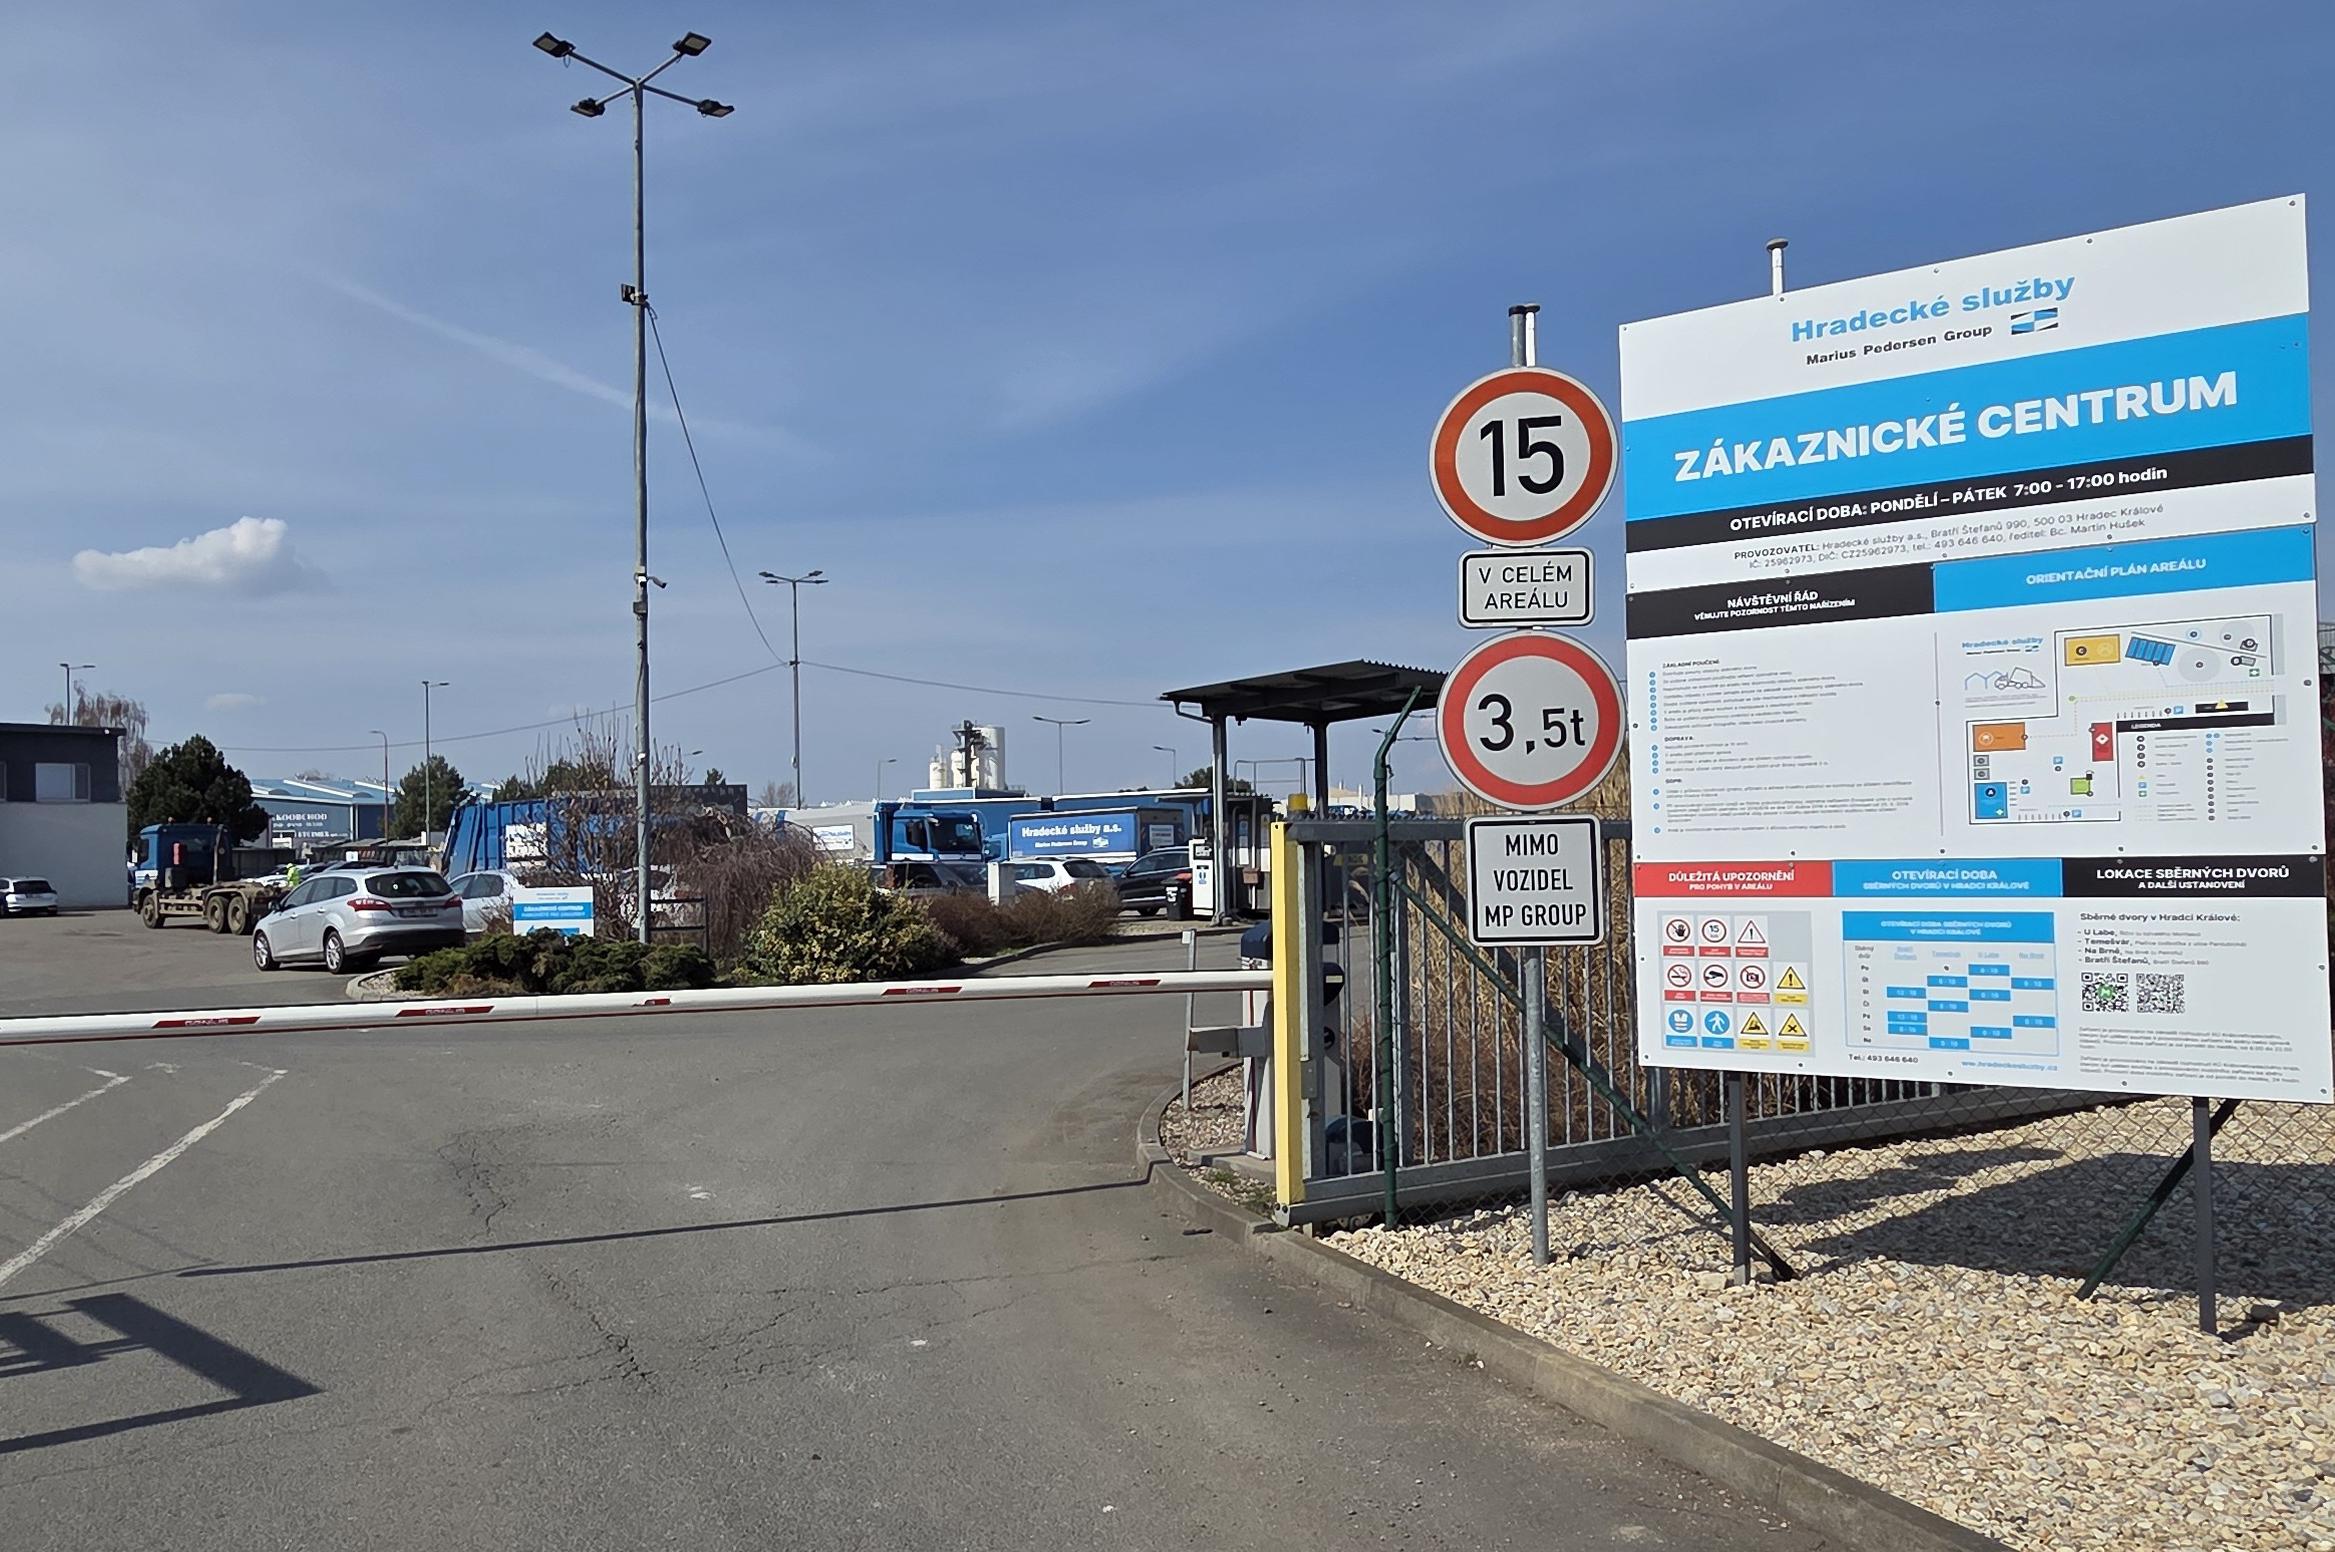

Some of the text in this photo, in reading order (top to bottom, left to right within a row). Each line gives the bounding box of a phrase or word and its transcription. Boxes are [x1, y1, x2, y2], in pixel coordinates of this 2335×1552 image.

[1792, 276, 2075, 342] Hradecké služby
[1806, 325, 1993, 365] Marius Pedersen Group
[1674, 370, 2238, 482] ZÁKAZNICKÉ CENTRUM
[1480, 415, 1564, 497] 15
[1729, 507, 1814, 531] OTEVÍRACÍ
[1816, 504, 1867, 521] DOBA:
[1870, 491, 1939, 514] PONDĚLÍ
[1952, 487, 2007, 504] PÁTEK
[2014, 480, 2052, 496] 7:00
[2066, 473, 2115, 490] 17:00
[2118, 466, 2168, 484] hodin
[1734, 543, 1820, 560] PROVOZOVATEL:
[1822, 538, 1869, 550] Hradecké
[1872, 533, 1904, 545] služby
[1931, 527, 1959, 538] Bratří
[1961, 523, 2003, 535] Štefanů
[2006, 520, 2030, 530] 990,
[2034, 516, 2055, 526] 500
[2058, 514, 2073, 524] 03
[2076, 510, 2117, 522] Hradec
[2120, 504, 2164, 517] Králové
[1934, 538, 1955, 549] 493
[1957, 536, 1979, 546] 646
[2050, 527, 2066, 537] Bc.
[2070, 522, 2106, 534] Martin
[2110, 518, 2146, 530] Hušek
[1479, 561, 1572, 584] V CELÉM
[2026, 558, 2207, 585] ORIENTAČNÍ PLÁN AREÁLU
[1484, 587, 1568, 610] AREÁLU
[1727, 590, 1818, 608] NÁVŠTĚVNÍ ŘÁD
[1730, 606, 1779, 617] POZORNOST
[1505, 833, 1559, 856] MIMO
[1493, 868, 1573, 892] VOZIDEL
[1668, 869, 1795, 882] DŮLEŽITÁ UPOZORNĚNÍ
[1892, 868, 1998, 880] OTEVÍRACÍ DOBA
[2096, 865, 2290, 879] LOKACE SBĚRNÝCH DVORŮ
[2138, 880, 2245, 889] A DALŠÍ USTANOVENÍ
[1485, 903, 1587, 927] MP GROUP
[2080, 912, 2116, 921] Sběrné
[2119, 913, 2148, 923] dvory
[2159, 913, 2194, 921] Hradci
[2196, 913, 2240, 922] Králové:
